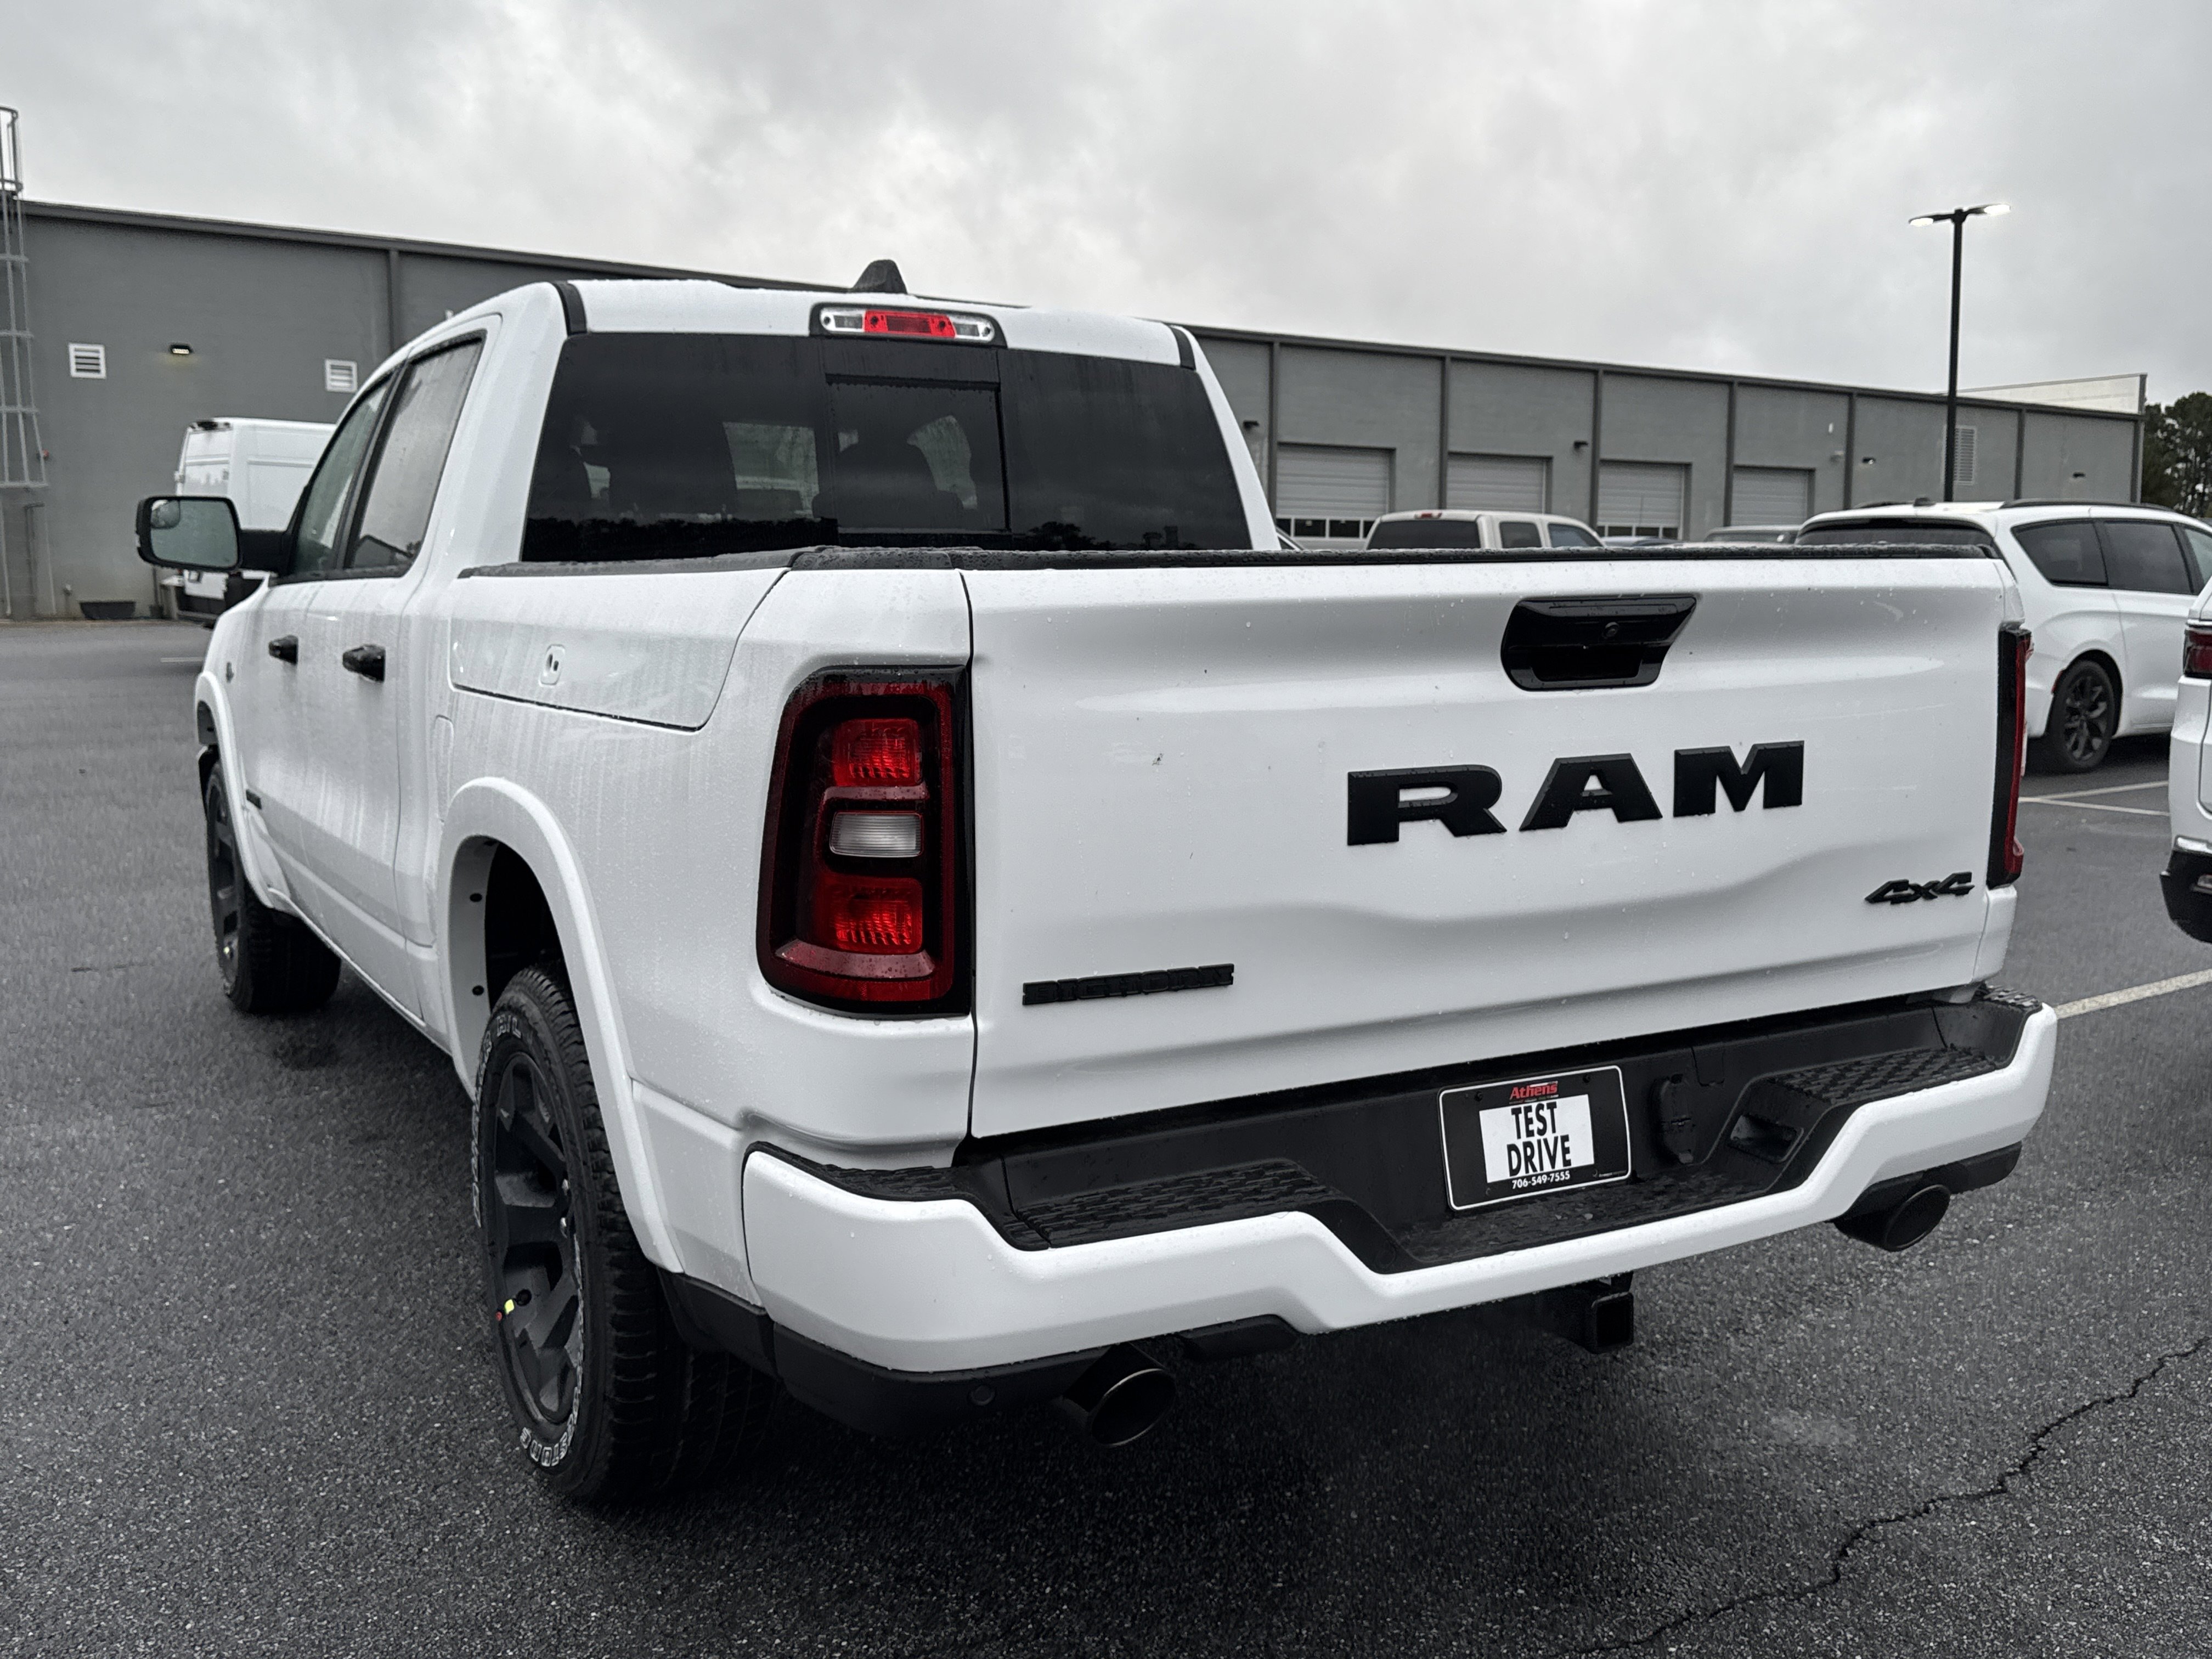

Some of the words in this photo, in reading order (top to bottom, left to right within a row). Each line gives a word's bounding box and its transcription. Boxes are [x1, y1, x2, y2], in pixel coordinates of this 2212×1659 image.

[1347, 740, 1804, 846] RAM
[1509, 1082, 1558, 1100] Athens
[1511, 1102, 1558, 1140] TEST
[1506, 1134, 1572, 1178] DRIVE
[1511, 1171, 1571, 1189] 706-549-7555
